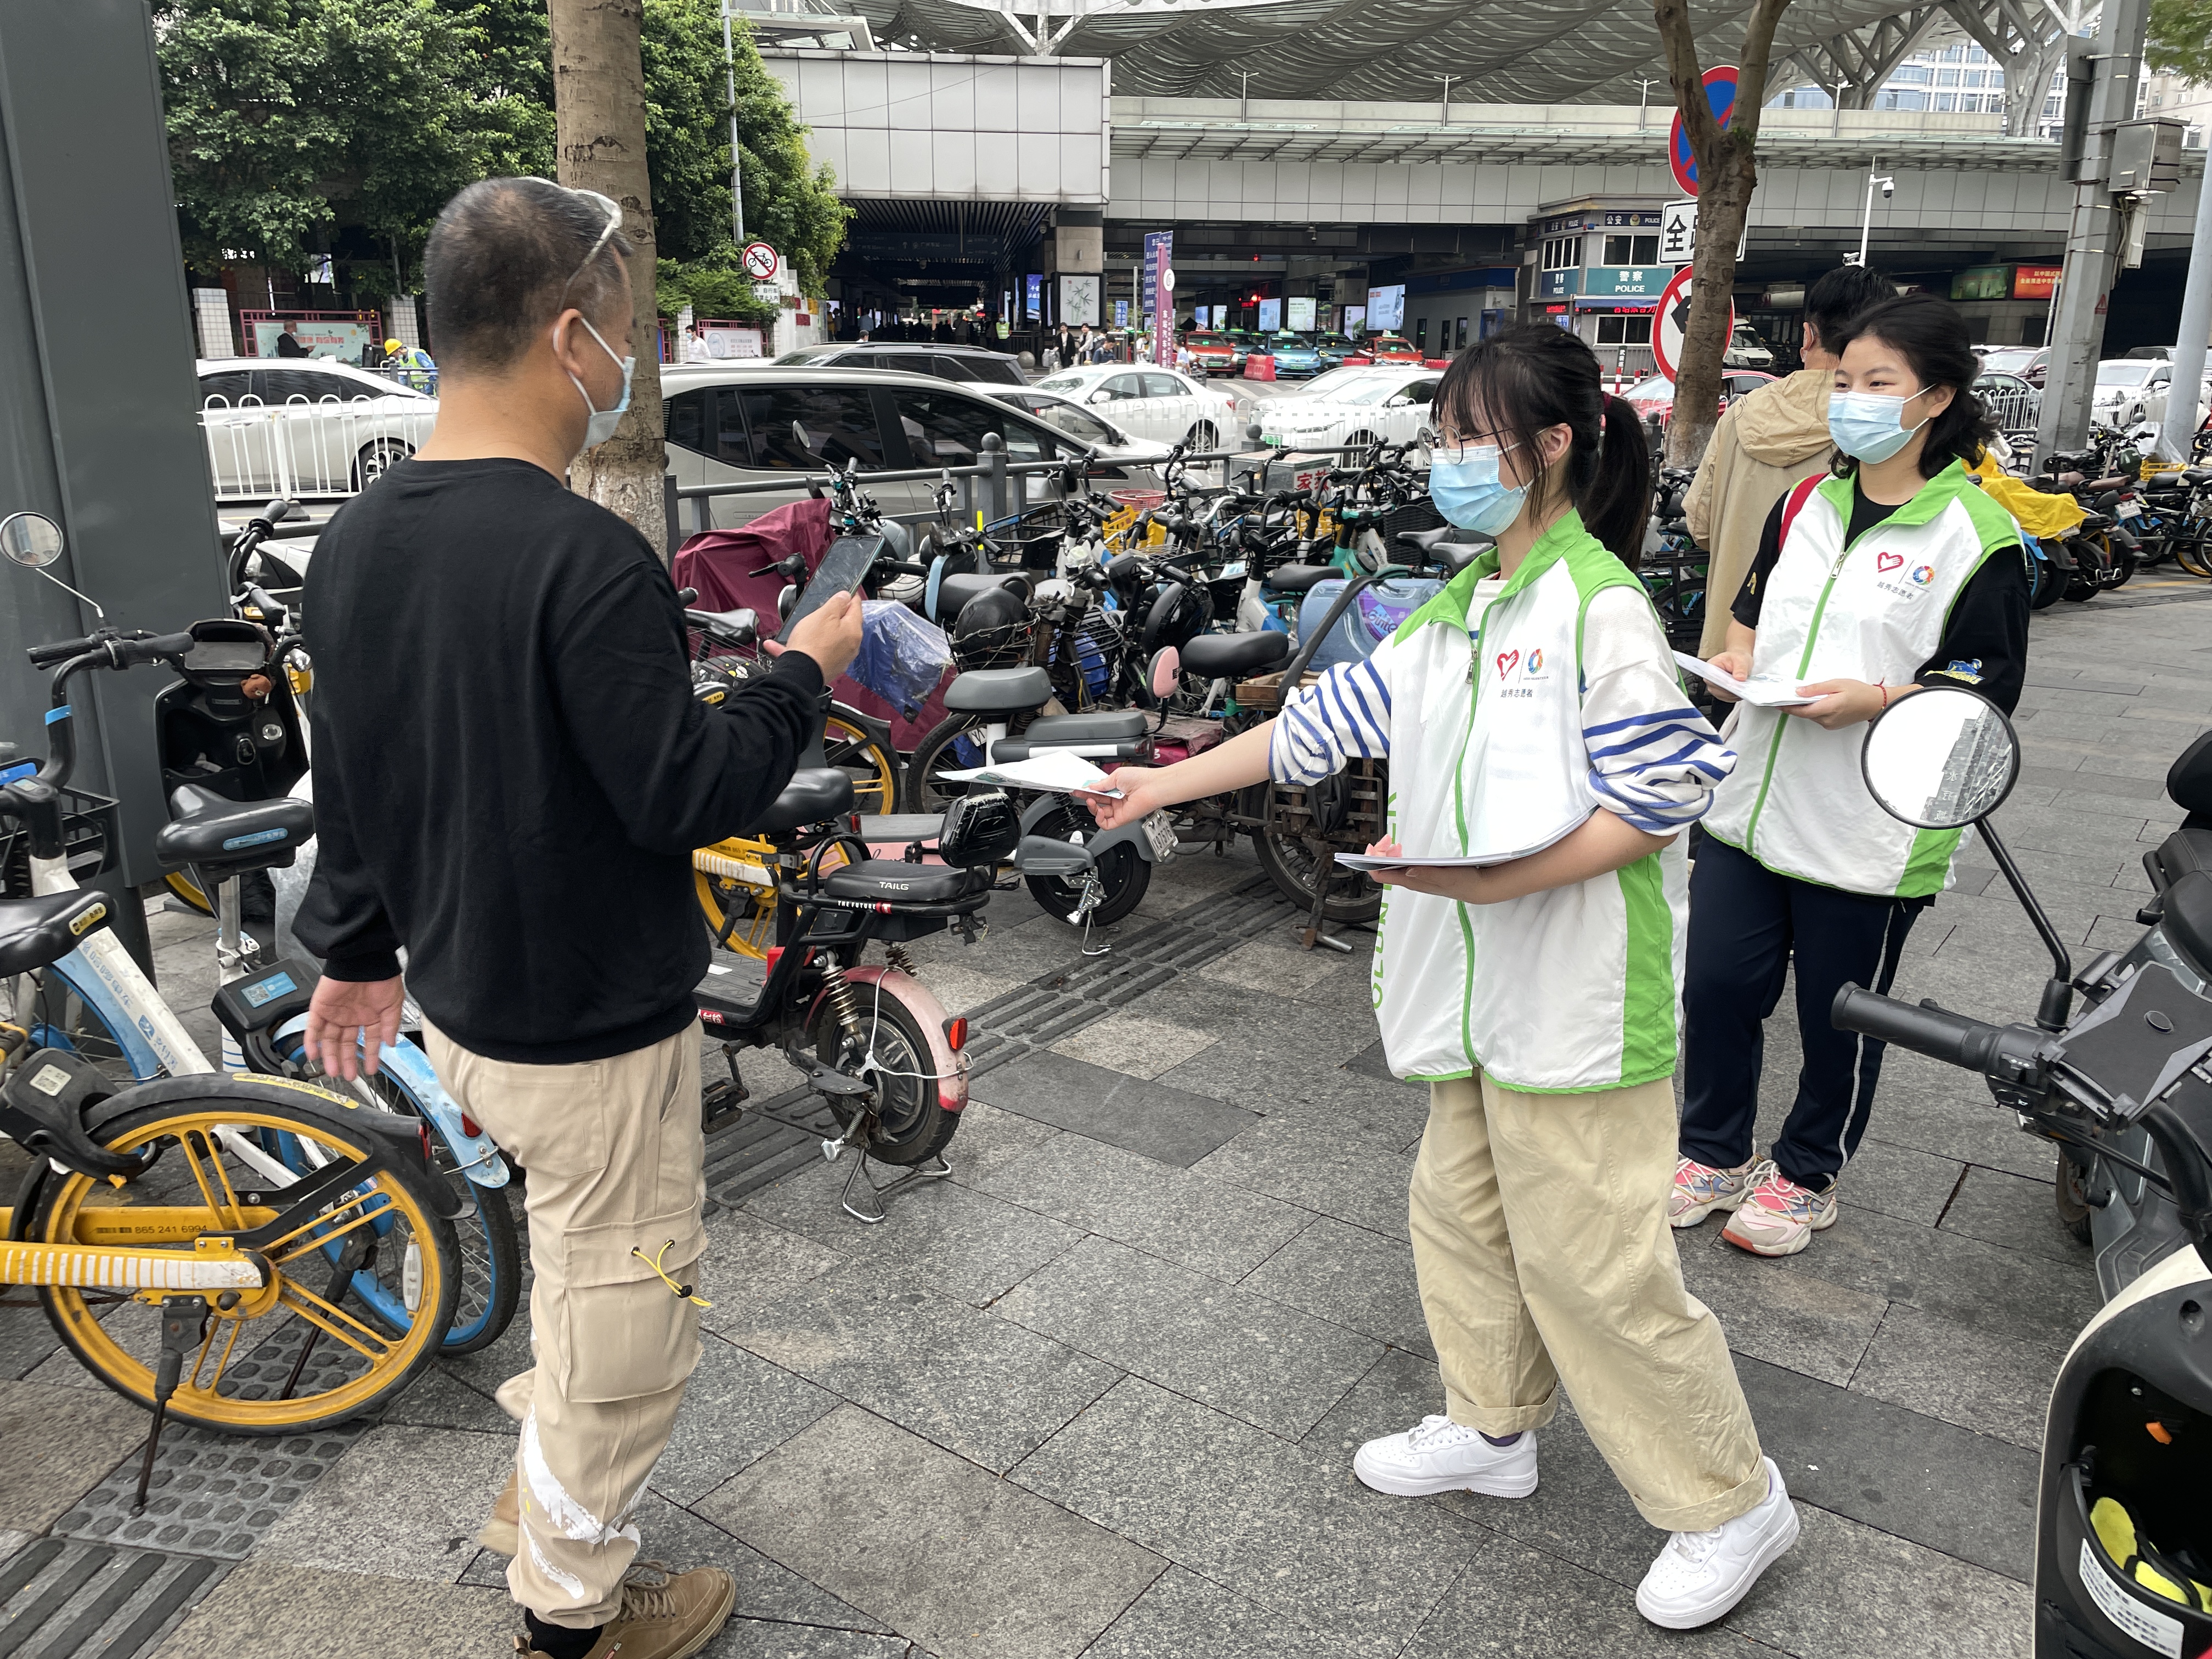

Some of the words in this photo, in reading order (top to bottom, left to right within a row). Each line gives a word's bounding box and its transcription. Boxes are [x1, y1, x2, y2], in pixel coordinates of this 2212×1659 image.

[1607, 215, 1622, 225] 公安
[1620, 270, 1643, 282] 警察
[1500, 689, 1533, 698] 越秀志愿者
[879, 882, 909, 890] TAILG
[851, 901, 876, 910] FUTURE
[181, 1224, 207, 1233] 6994
